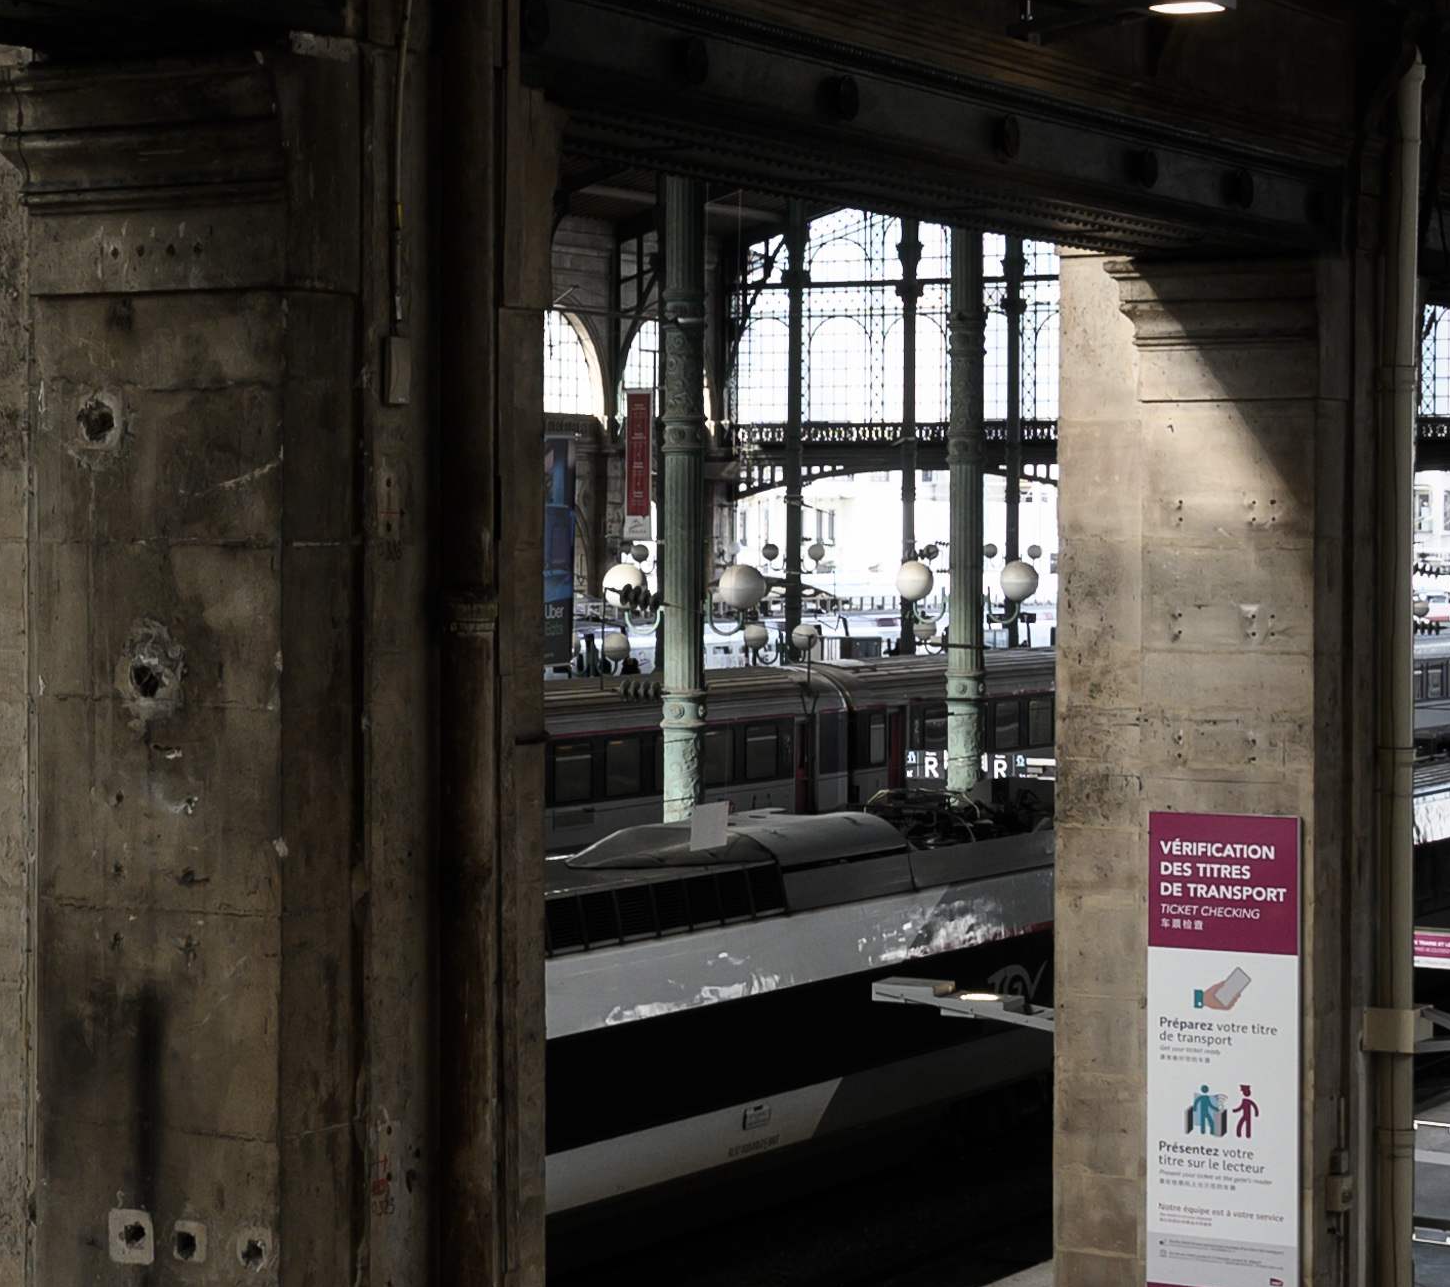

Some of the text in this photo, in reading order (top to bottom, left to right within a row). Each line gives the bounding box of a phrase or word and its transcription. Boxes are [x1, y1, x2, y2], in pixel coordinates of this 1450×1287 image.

[544, 604, 565, 619] Uber
[1160, 838, 1275, 859] VÉRIFICATION
[1160, 861, 1251, 879] DES TITRES
[1160, 882, 1287, 902] DE TRANSPORT
[1160, 903, 1260, 919] TICKET CHECKING
[1160, 1017, 1278, 1035] Préparez votre titre
[1160, 1030, 1232, 1046] de transport
[1159, 1140, 1254, 1160] Présentez votre
[1159, 1155, 1265, 1174] titre sur le lecteur
[1159, 1202, 1181, 1211] Notre
[1183, 1204, 1209, 1216] équipe
[1233, 1211, 1254, 1220] votre
[1256, 1212, 1284, 1222] service
